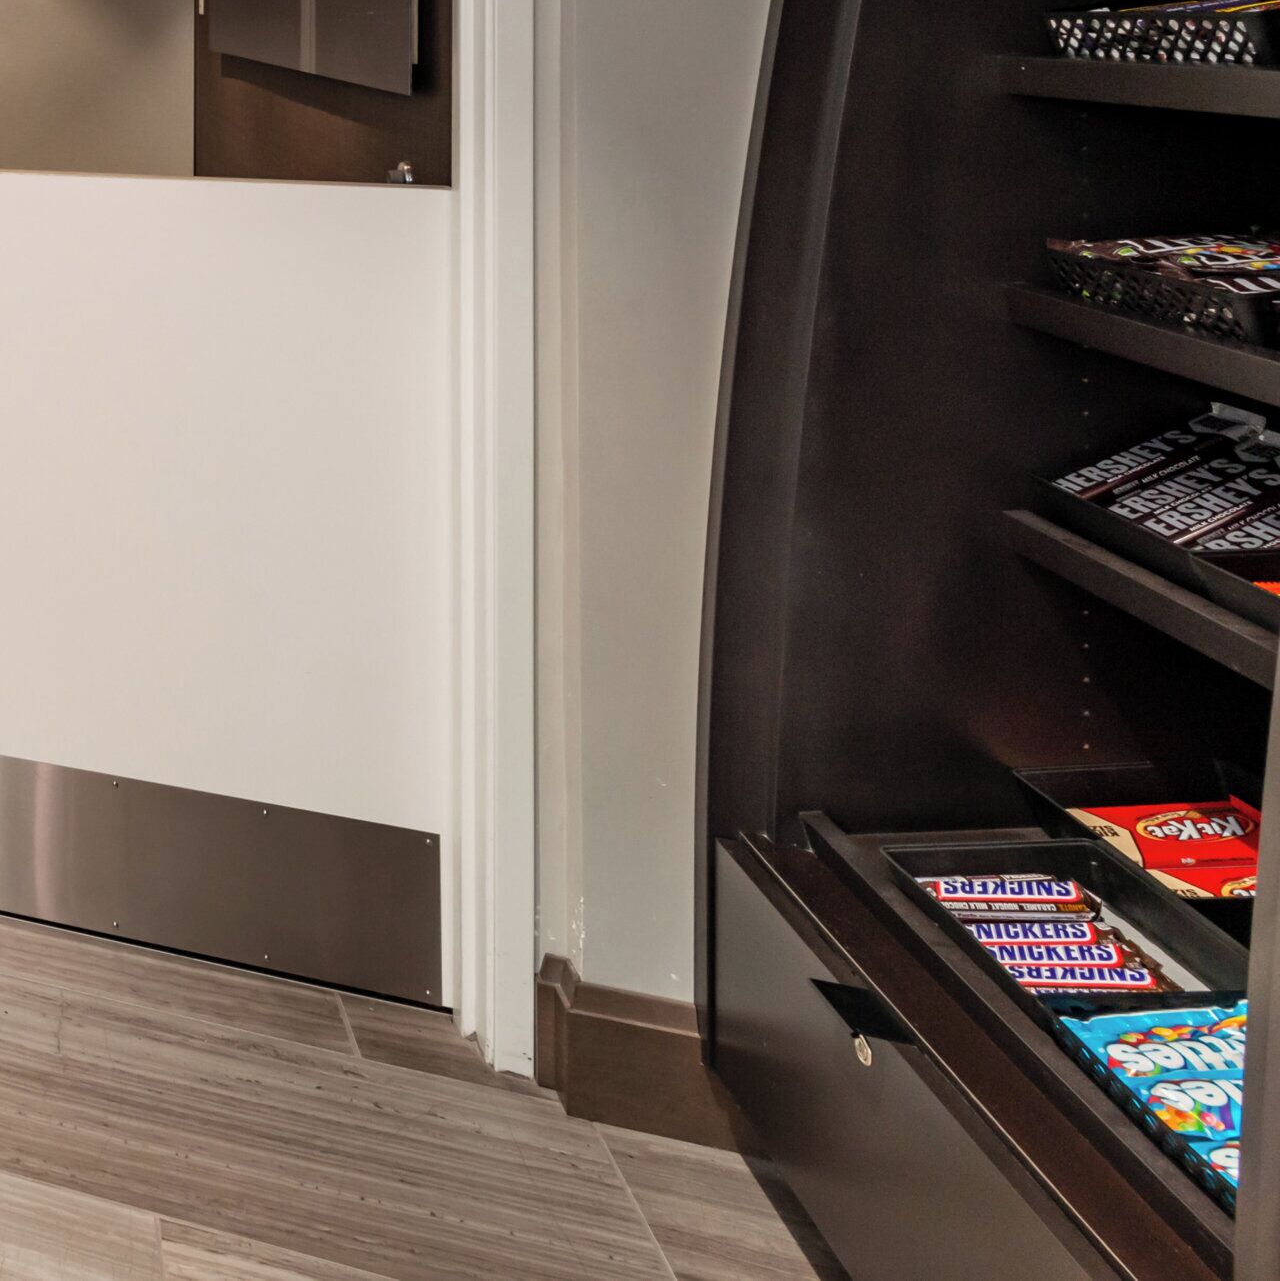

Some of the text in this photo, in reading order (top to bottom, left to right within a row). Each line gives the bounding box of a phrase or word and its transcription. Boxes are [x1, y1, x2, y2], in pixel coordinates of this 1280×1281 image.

[1052, 430, 1197, 493] HERSHEY'S
[1207, 500, 1254, 523] CHOCOLATE
[943, 880, 1075, 897] SNICKERS
